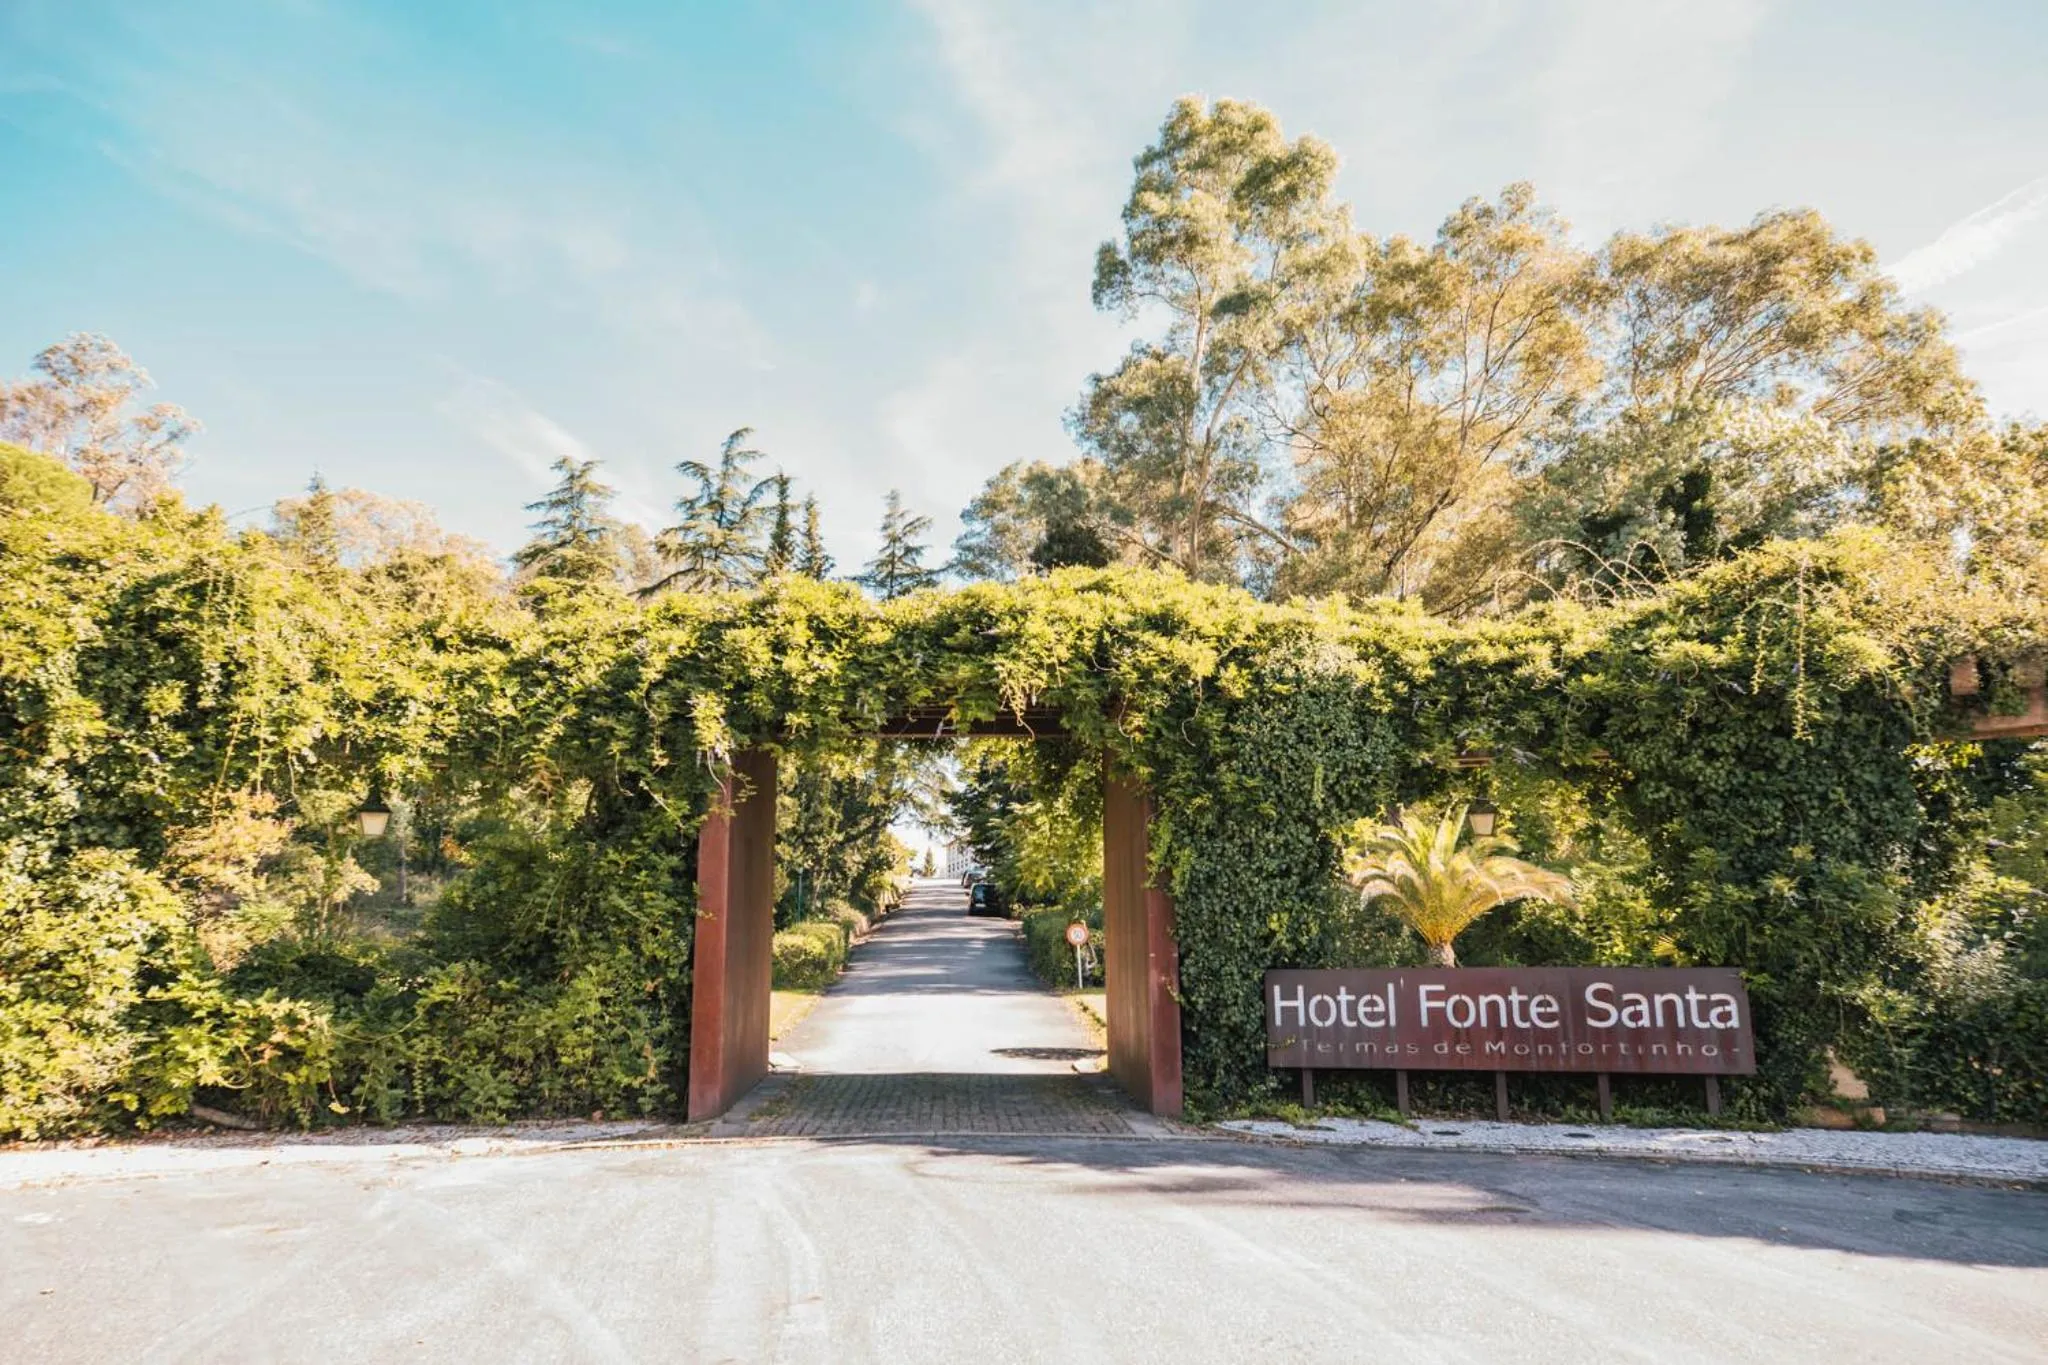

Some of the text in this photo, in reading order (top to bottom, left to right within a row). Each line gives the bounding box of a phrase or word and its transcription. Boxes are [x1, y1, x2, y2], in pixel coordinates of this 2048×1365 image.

[1273, 982, 1740, 1029] Hotel Fonte Santa
[1432, 1040, 1472, 1055] de
